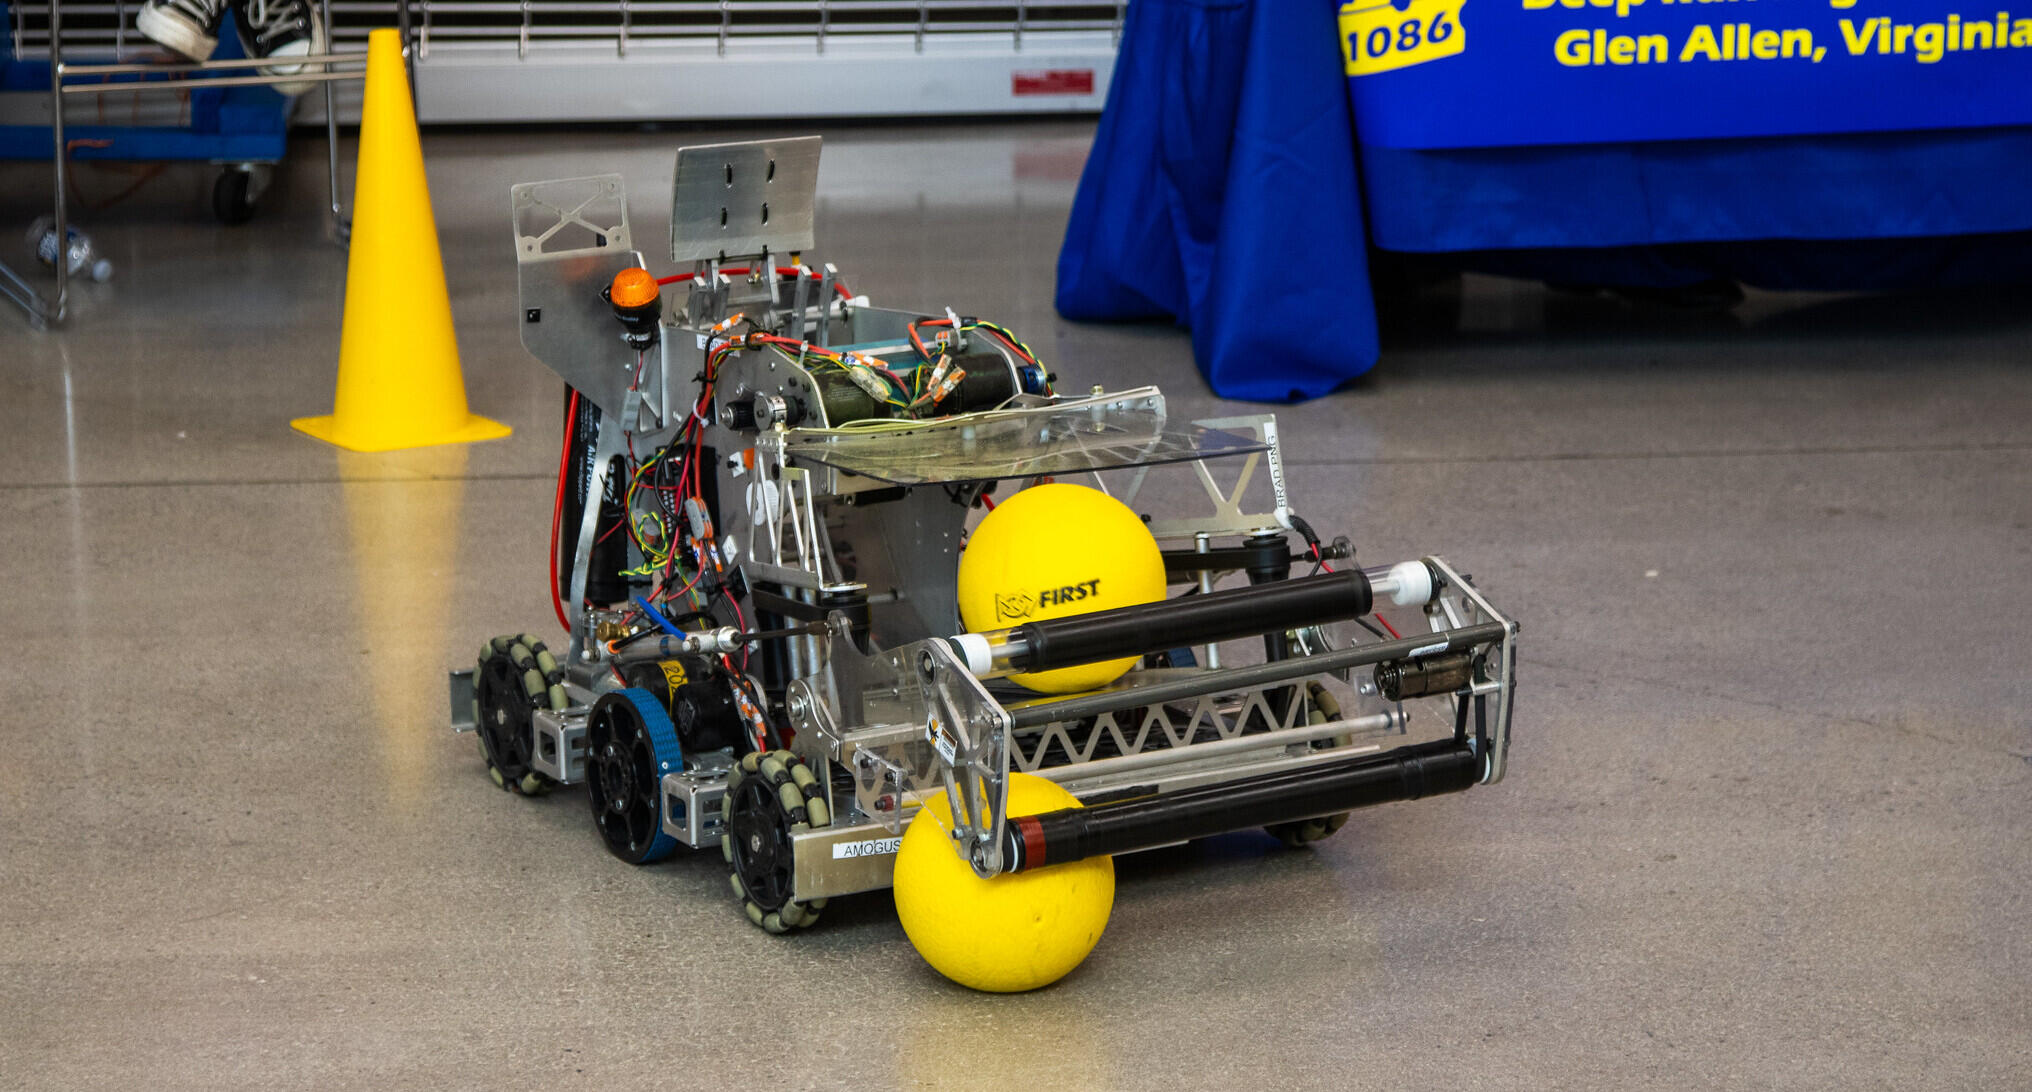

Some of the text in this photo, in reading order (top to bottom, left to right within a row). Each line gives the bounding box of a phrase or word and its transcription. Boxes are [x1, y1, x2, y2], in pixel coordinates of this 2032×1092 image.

[1347, 11, 1453, 62] 1086
[1554, 11, 2032, 67] Glen Allen, Virginia
[1039, 578, 1101, 609] FIRST
[843, 839, 901, 857] AMOGUS
